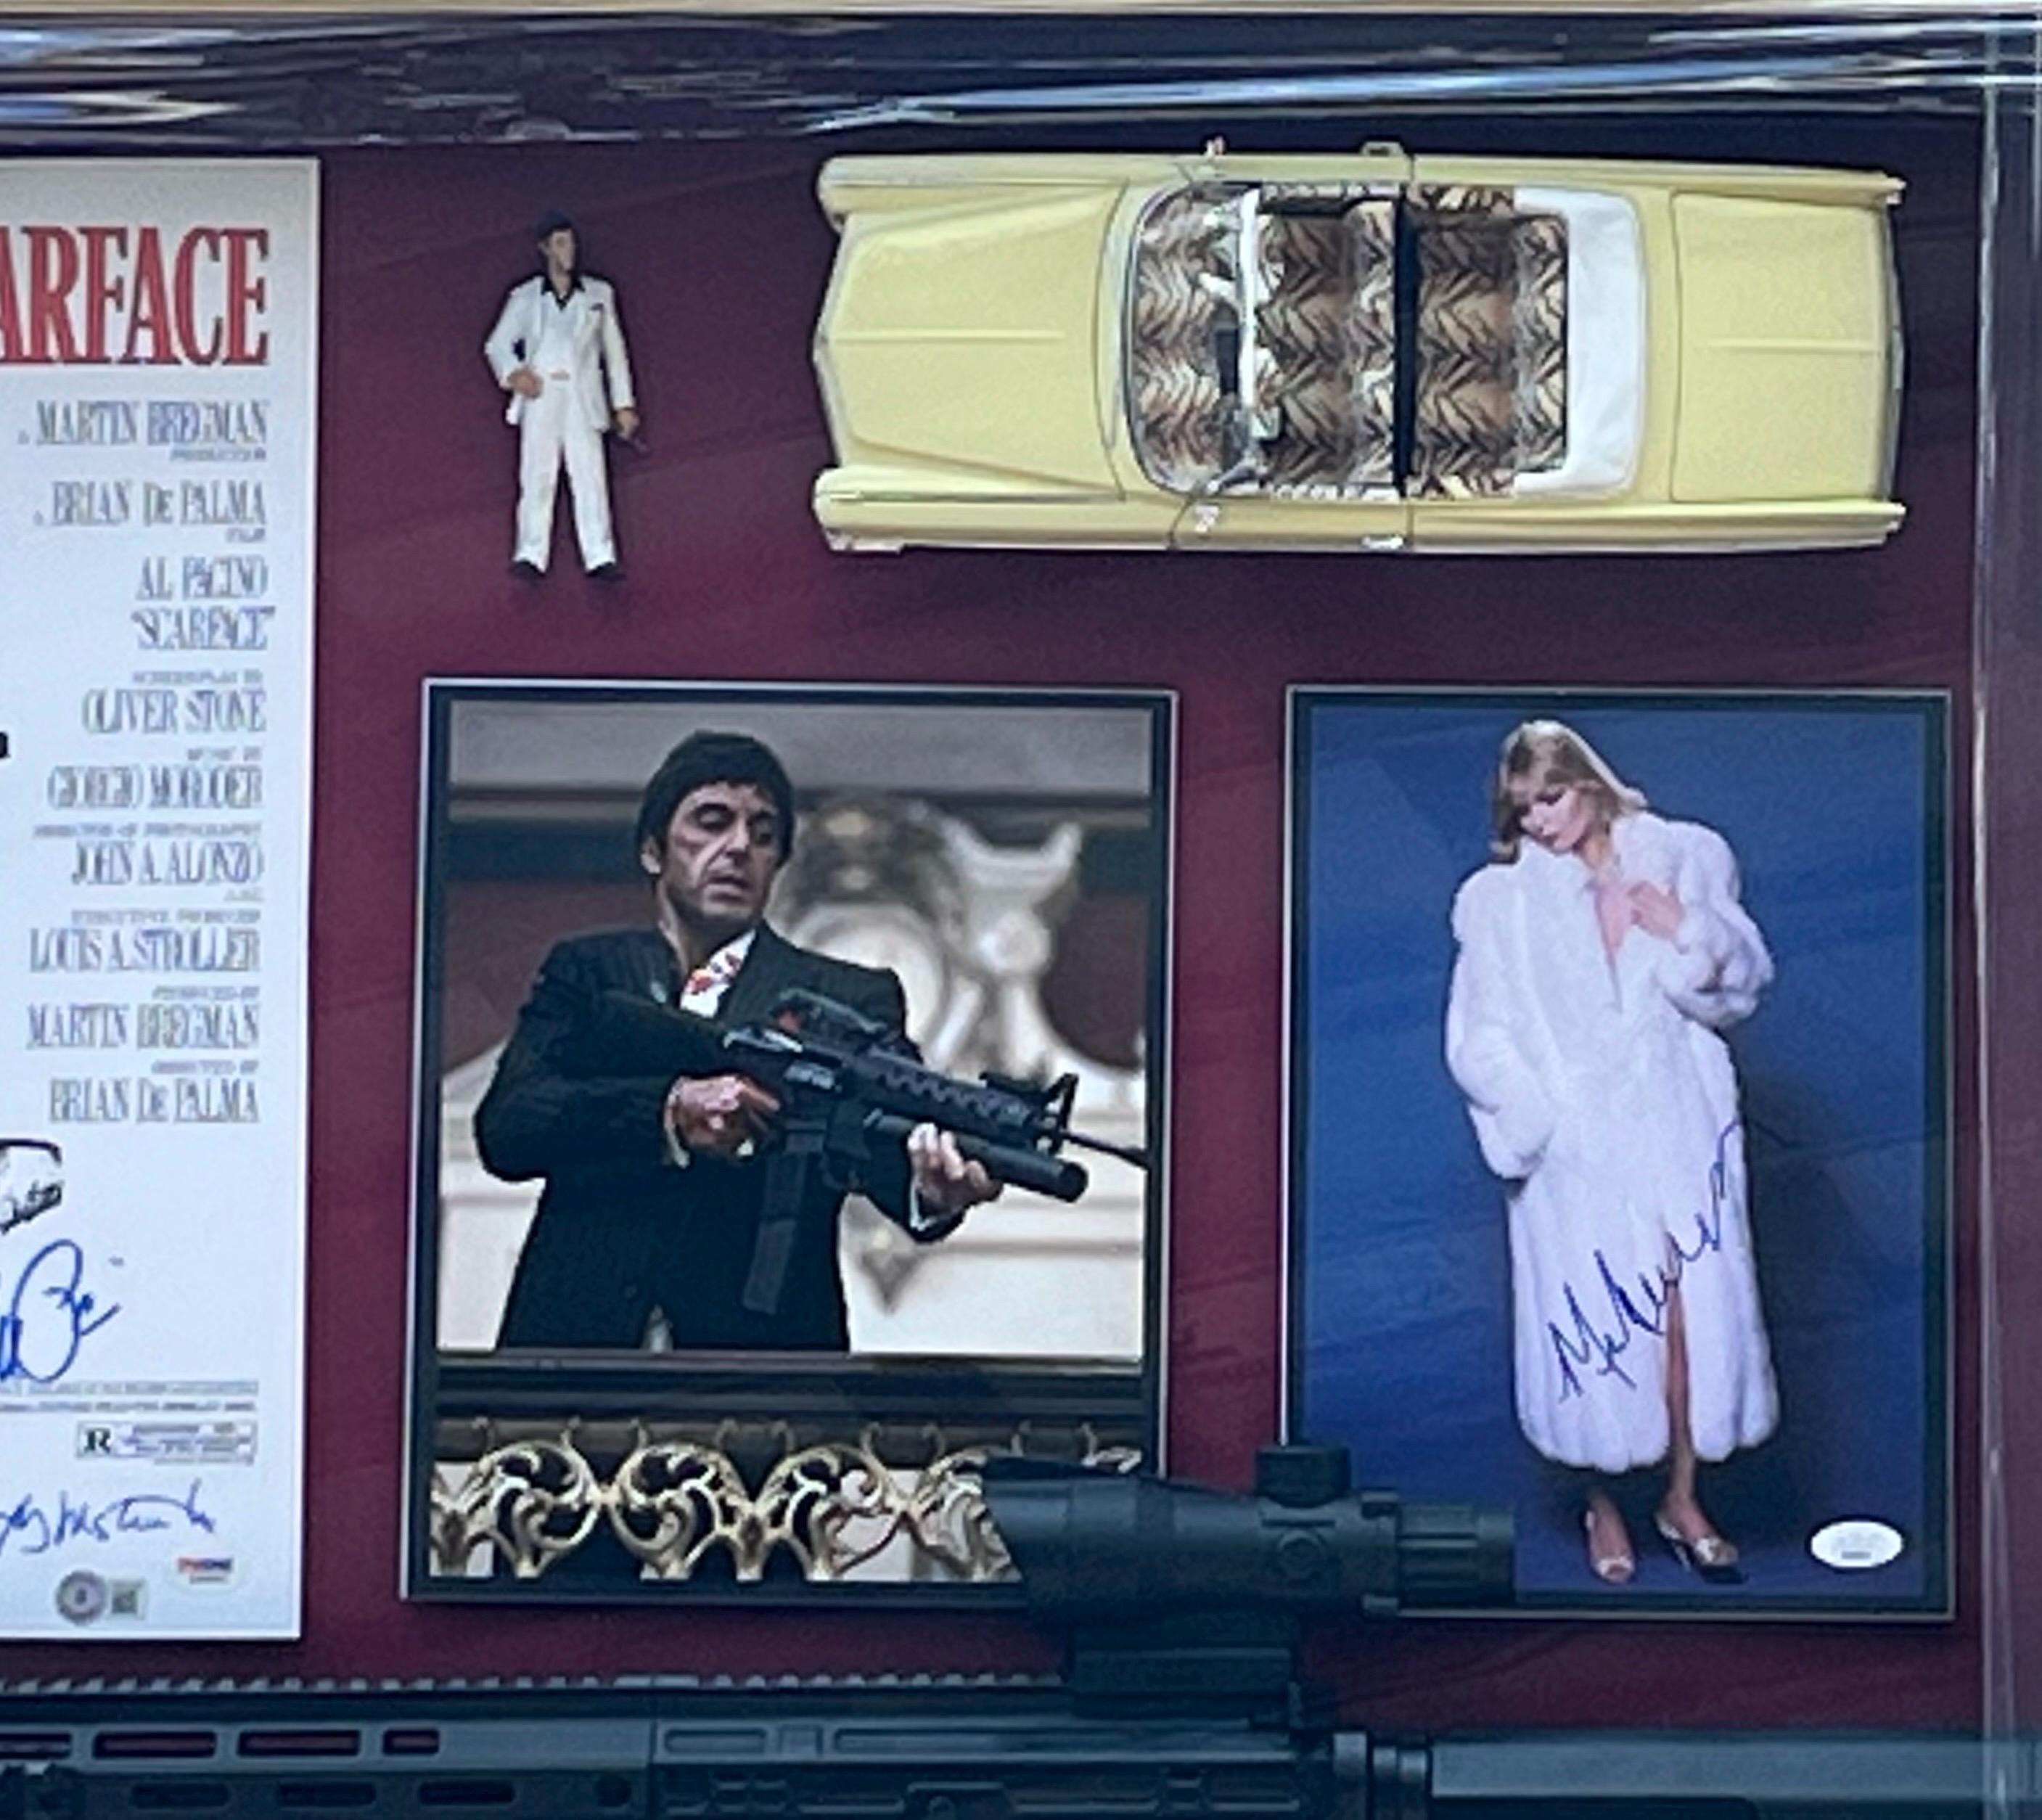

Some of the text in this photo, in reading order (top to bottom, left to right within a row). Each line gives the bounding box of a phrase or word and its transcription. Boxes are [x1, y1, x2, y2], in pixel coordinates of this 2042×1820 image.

[52, 480, 131, 526] BRIAN
[179, 480, 266, 525] PALMA
[135, 556, 173, 601] AL
[82, 688, 268, 734] OLIVER STONE
[27, 1004, 130, 1050] MARTIN
[49, 1078, 131, 1124] BRIAN
[173, 1077, 261, 1124] PALMA
[84, 1428, 112, 1454] R
